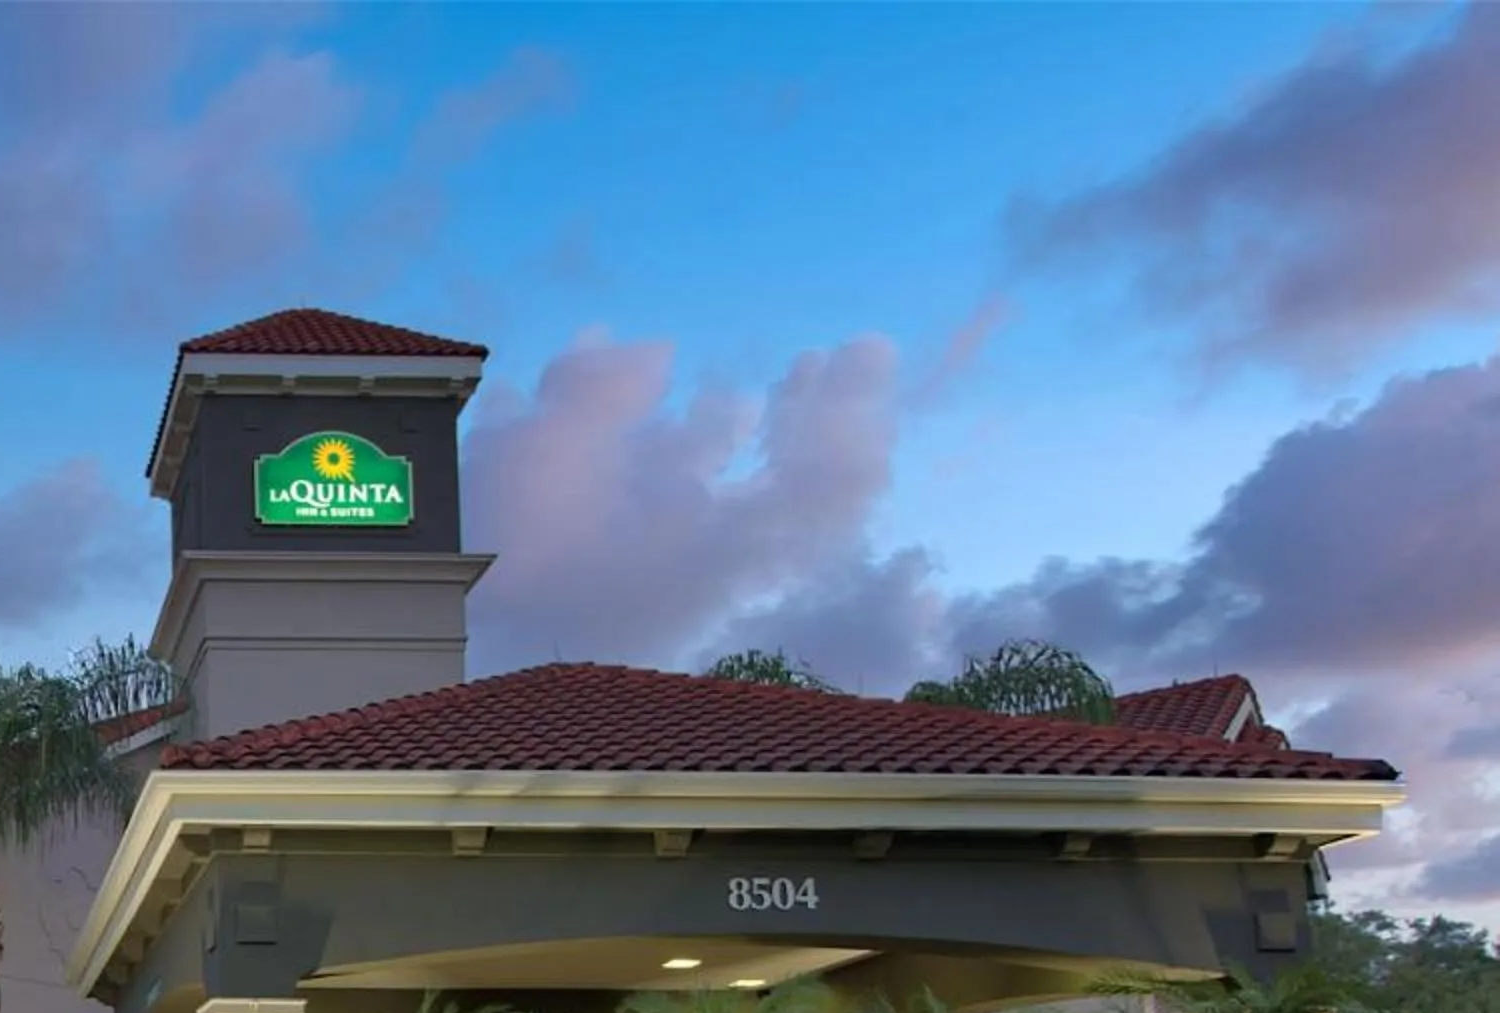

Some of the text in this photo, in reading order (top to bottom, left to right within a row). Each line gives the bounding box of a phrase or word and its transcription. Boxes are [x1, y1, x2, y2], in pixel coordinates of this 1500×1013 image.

[269, 479, 404, 508] LA QUINTA
[728, 877, 819, 910] 8504
